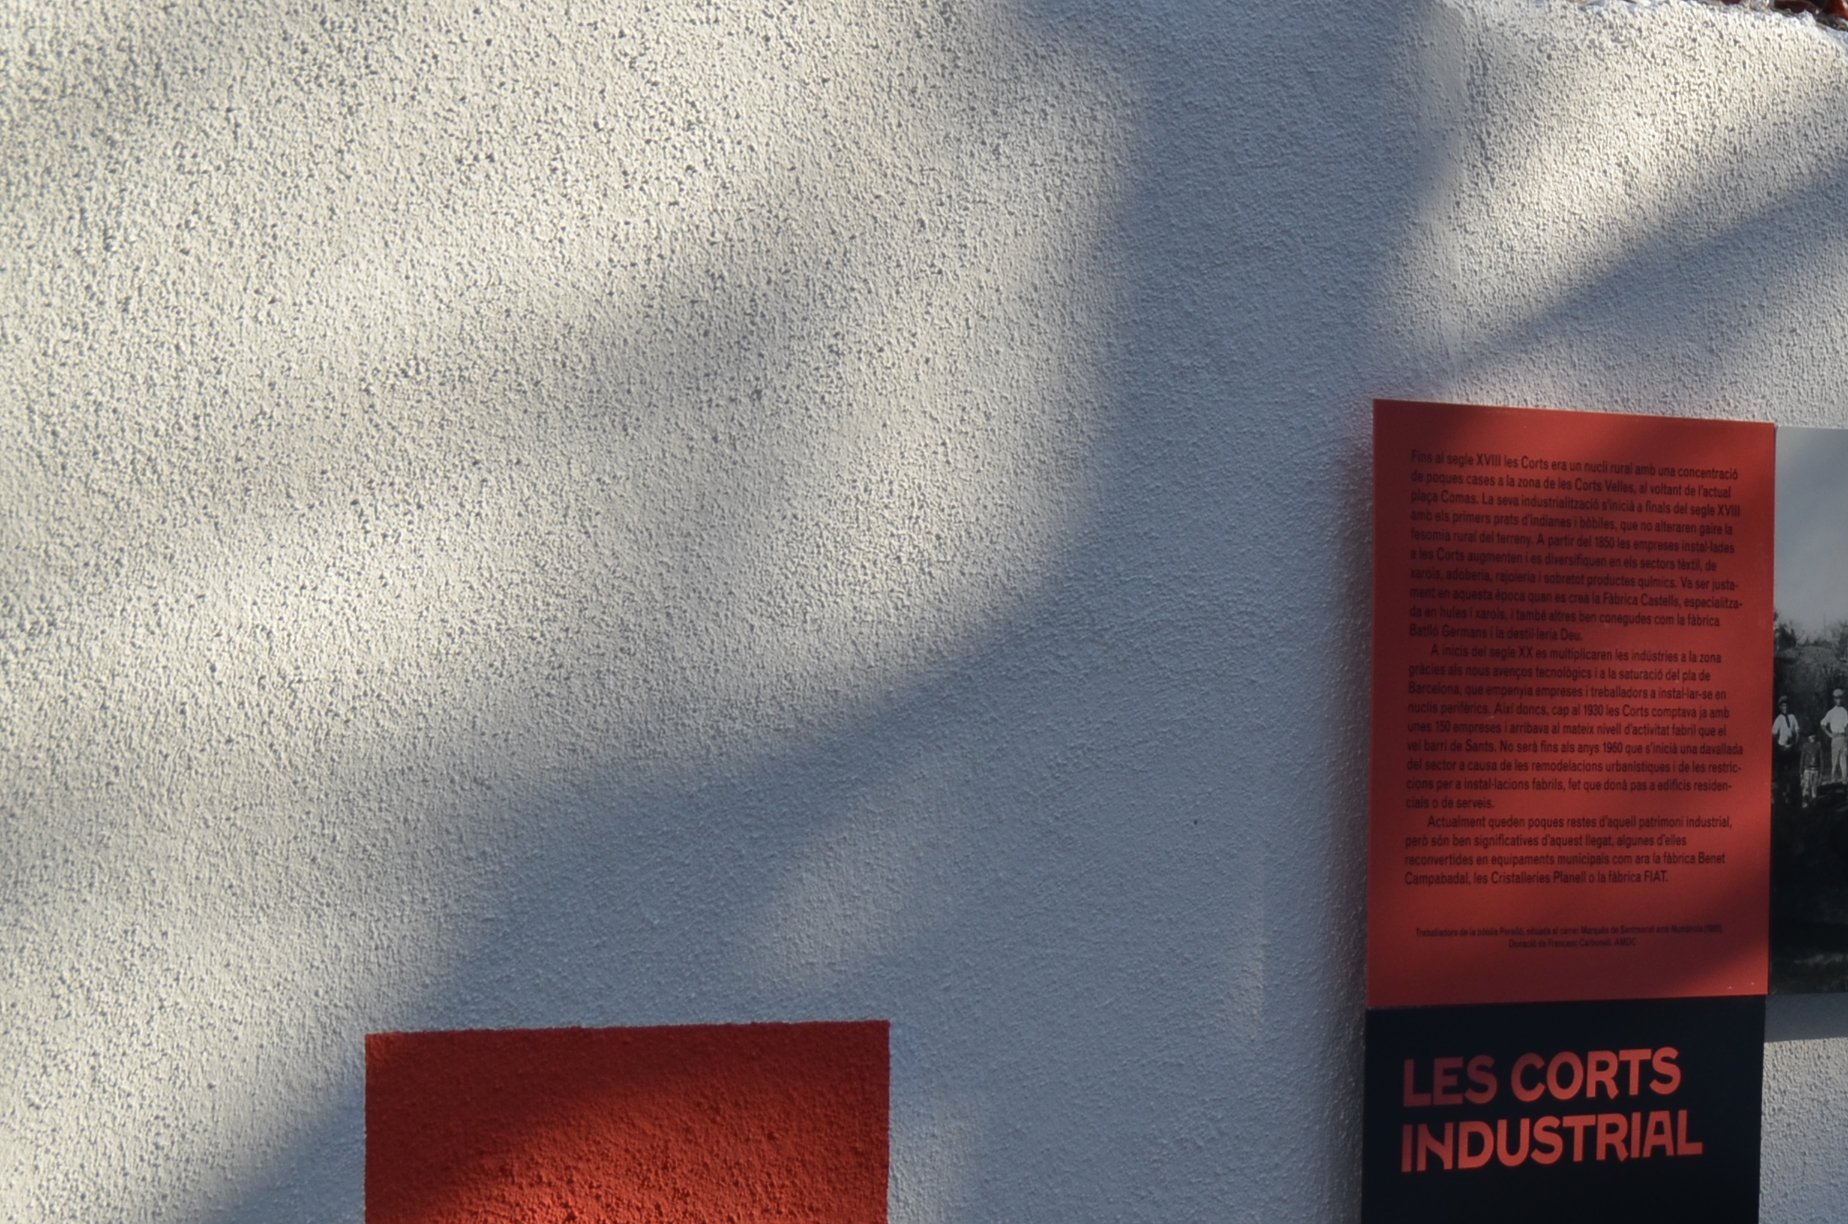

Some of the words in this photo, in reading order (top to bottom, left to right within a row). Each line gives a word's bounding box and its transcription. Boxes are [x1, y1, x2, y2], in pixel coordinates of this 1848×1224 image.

[1410, 450, 1431, 464] Fins
[1435, 451, 1444, 465] al
[1447, 452, 1473, 469] segle
[1476, 453, 1500, 468] XVIII
[1504, 455, 1518, 468] les
[1521, 456, 1548, 470] Corts
[1551, 460, 1567, 471] era
[1569, 461, 1581, 472] un
[1584, 459, 1608, 473] nucli
[1610, 461, 1632, 475] rural
[1635, 462, 1655, 476] amb
[1658, 466, 1675, 477] una
[1411, 469, 1422, 483] de
[1425, 473, 1463, 488] poques
[1466, 475, 1494, 486] cases
[1506, 474, 1515, 487] la
[1518, 478, 1540, 489] zona
[1544, 476, 1554, 489] de
[1558, 477, 1571, 490] les
[1575, 478, 1602, 492] Corts
[1639, 481, 1647, 494] al
[1650, 482, 1681, 496] voltant
[1684, 483, 1695, 497] de
[1442, 643, 1468, 657] inicis
[1472, 644, 1486, 658] del
[1490, 645, 1515, 661] segle
[1519, 645, 1532, 659] XX
[1536, 649, 1546, 659] es
[1550, 646, 1612, 663] multiplicaren
[1615, 648, 1628, 661] les
[1688, 650, 1696, 663] la
[1700, 653, 1722, 663] zona
[1408, 700, 1437, 714] nuclis
[1552, 706, 1569, 719] cap
[1571, 703, 1580, 716] al
[1584, 703, 1603, 716] 1930
[1606, 703, 1619, 717] les
[1622, 704, 1648, 717] Corts
[1651, 704, 1696, 720] comptava
[1699, 705, 1707, 720] ja
[1710, 705, 1730, 718] amb
[1424, 739, 1446, 752] barri
[1450, 739, 1461, 752] de
[1499, 739, 1513, 753] No
[1540, 740, 1558, 753] fins
[1561, 740, 1574, 753] als
[1577, 743, 1599, 756] anys
[1603, 740, 1622, 753] 1960
[1625, 744, 1642, 756] que
[1680, 744, 1697, 754] una
[1700, 741, 1743, 754] davallada
[1407, 758, 1421, 771] del
[1425, 758, 1455, 771] sector
[1467, 761, 1497, 772] causa
[1500, 758, 1511, 772] de
[1514, 759, 1528, 772] les
[1531, 759, 1602, 772] remodelacions
[1679, 760, 1690, 773] de
[1692, 760, 1705, 773] les
[1708, 760, 1741, 773] restric-
[1406, 777, 1433, 790] cions
[1436, 780, 1452, 793] per
[1568, 777, 1581, 791] fet
[1583, 781, 1602, 793] que
[1630, 781, 1646, 793] pas
[1657, 778, 1690, 791] edificis
[1694, 778, 1731, 791] residen-
[1406, 795, 1428, 809] cials
[1442, 795, 1453, 809] de
[1427, 815, 1485, 828] Actualment
[1488, 815, 1525, 831] queden
[1528, 818, 1563, 831] poques
[1567, 815, 1596, 828] restes
[1638, 815, 1683, 830] patrimoni
[1452, 834, 1470, 847] ben
[1474, 833, 1538, 850] significatives
[1617, 833, 1653, 849] algunes
[1404, 852, 1472, 866] reconvertides
[1476, 855, 1487, 866] en
[1491, 852, 1554, 868] equipaments
[1557, 851, 1609, 868] municipals
[1612, 854, 1632, 864] com
[1635, 854, 1649, 864] ara
[1652, 851, 1660, 864] la
[1698, 850, 1724, 863] Benet
[1473, 871, 1487, 885] les
[1491, 870, 1551, 884] Cristalleries
[1552, 870, 1586, 883] Planell
[1597, 870, 1606, 883] la
[1403, 1055, 1497, 1107] LES
[1511, 1047, 1681, 1102] CORTS
[1401, 1109, 1703, 1172] INDUSTRIAL
